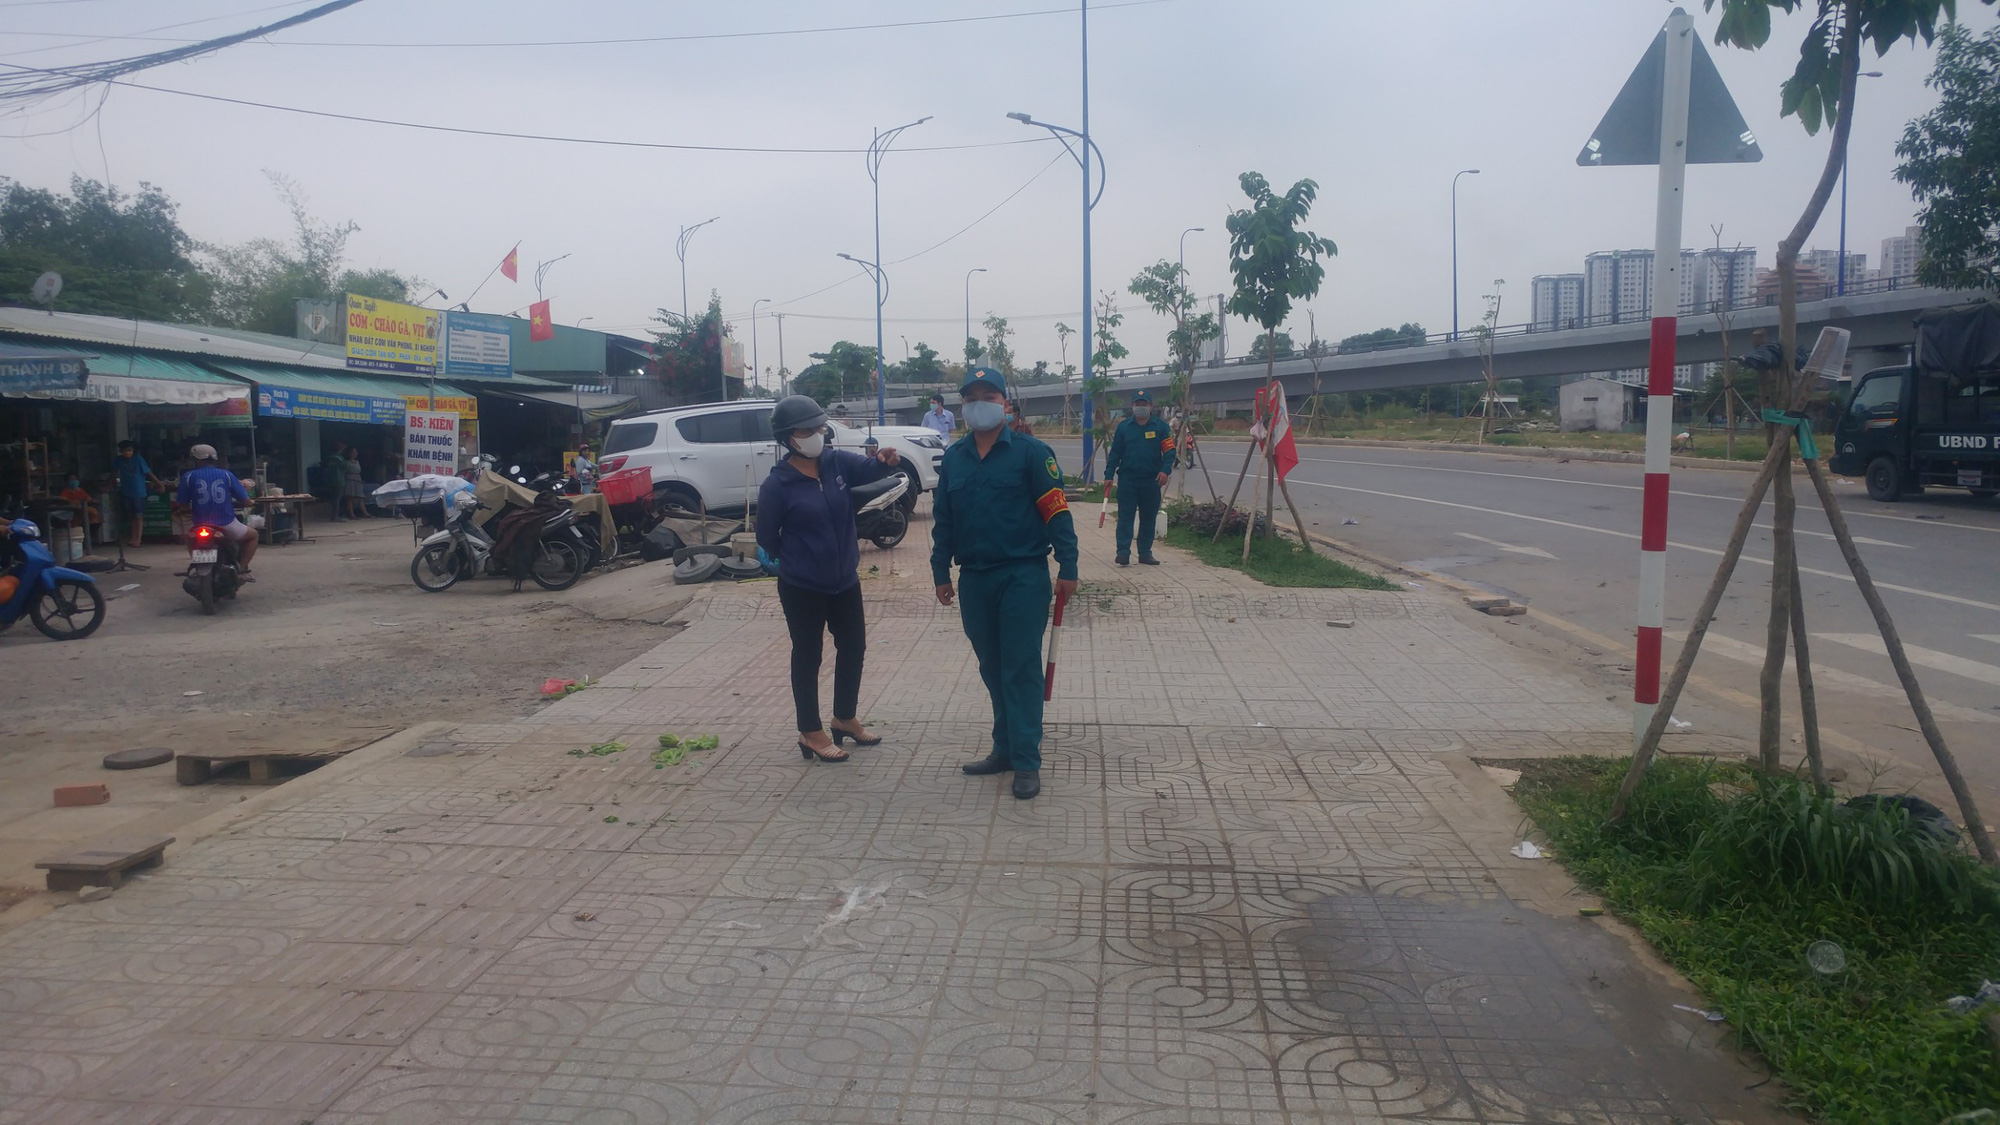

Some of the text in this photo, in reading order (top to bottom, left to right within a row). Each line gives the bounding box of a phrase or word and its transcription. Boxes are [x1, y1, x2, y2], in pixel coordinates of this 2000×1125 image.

[350, 312, 368, 329] CƠM
[374, 316, 396, 333] CHÁO
[398, 319, 411, 337] GÀ,
[413, 323, 425, 341] VỊT
[104, 380, 120, 399] ÍCH
[410, 416, 454, 431] BS: KIÊN
[410, 432, 453, 447] BÁN THUỐC
[1939, 435, 1987, 449] UBND
[408, 447, 453, 462] KHÁM BỆNH
[195, 479, 226, 505] 36
